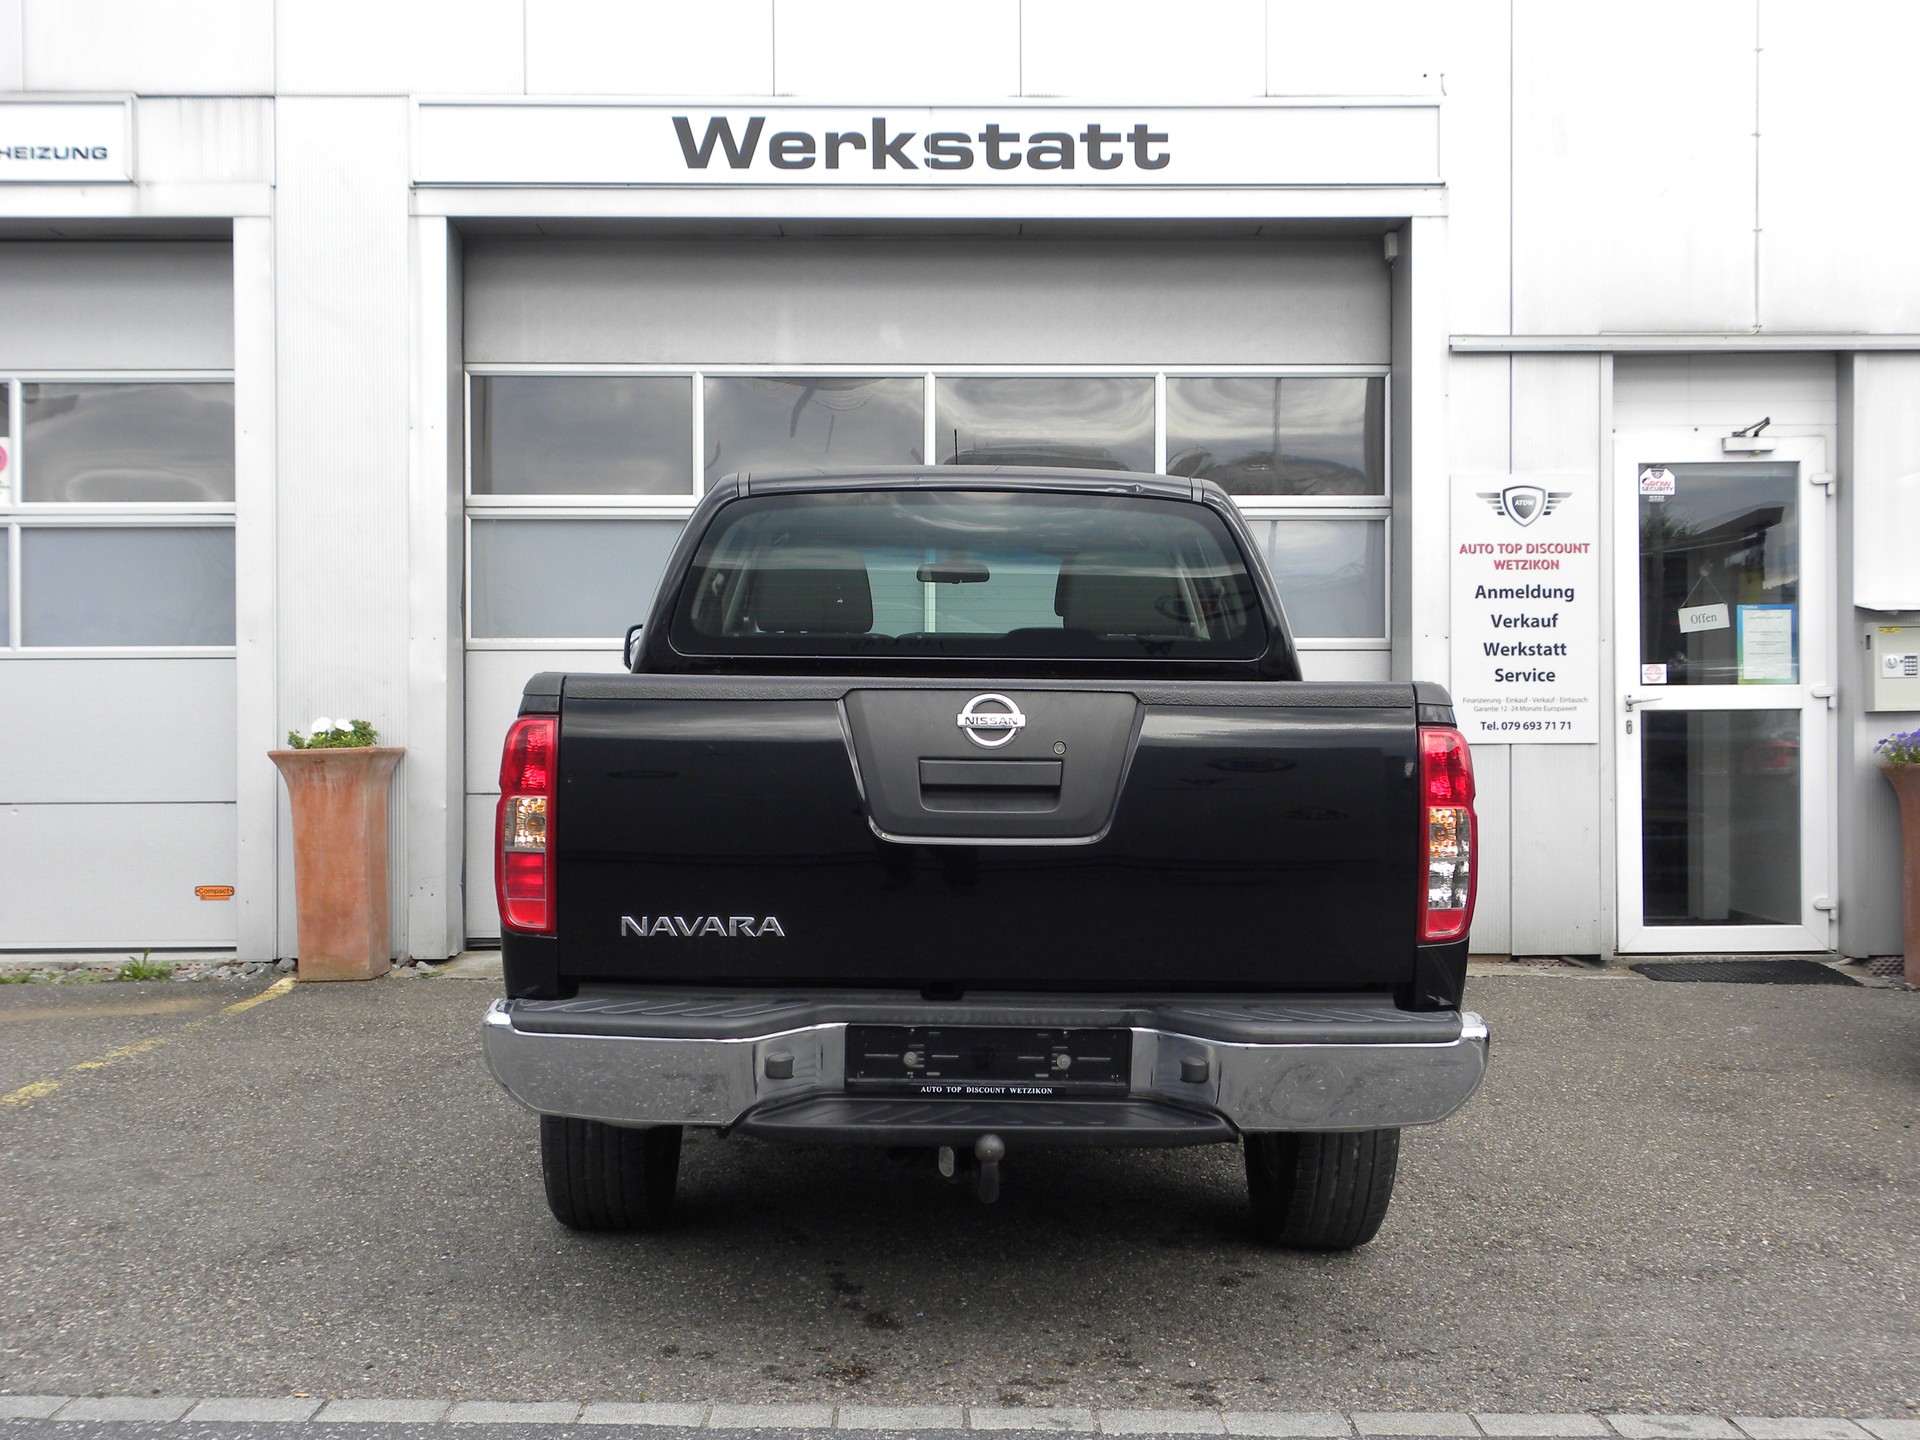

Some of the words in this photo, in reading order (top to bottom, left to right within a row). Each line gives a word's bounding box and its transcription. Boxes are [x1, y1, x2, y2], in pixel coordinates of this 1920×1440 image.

[671, 116, 1171, 170] Werkstatt
[1459, 543, 1494, 554] AUTO
[1497, 543, 1523, 554] TOP
[1525, 543, 1590, 554] DISCOUNT
[1493, 559, 1560, 570] WETZIKON
[1475, 584, 1575, 602] Anmeldung
[1490, 613, 1558, 628] Verkauf
[1690, 613, 1717, 624] Offen
[1483, 641, 1567, 656] Werkstatt
[1494, 667, 1556, 682] Service
[964, 716, 1018, 725] NISSAN
[1480, 721, 1499, 731] Tel.
[1501, 721, 1521, 731] 079
[1522, 721, 1542, 731] 693
[1544, 721, 1557, 731] 71
[1559, 721, 1572, 731] 71
[621, 916, 786, 937] NAVARA
[966, 1086, 1006, 1094] DISCOUNT
[1009, 1087, 1053, 1095] WETZIKON
